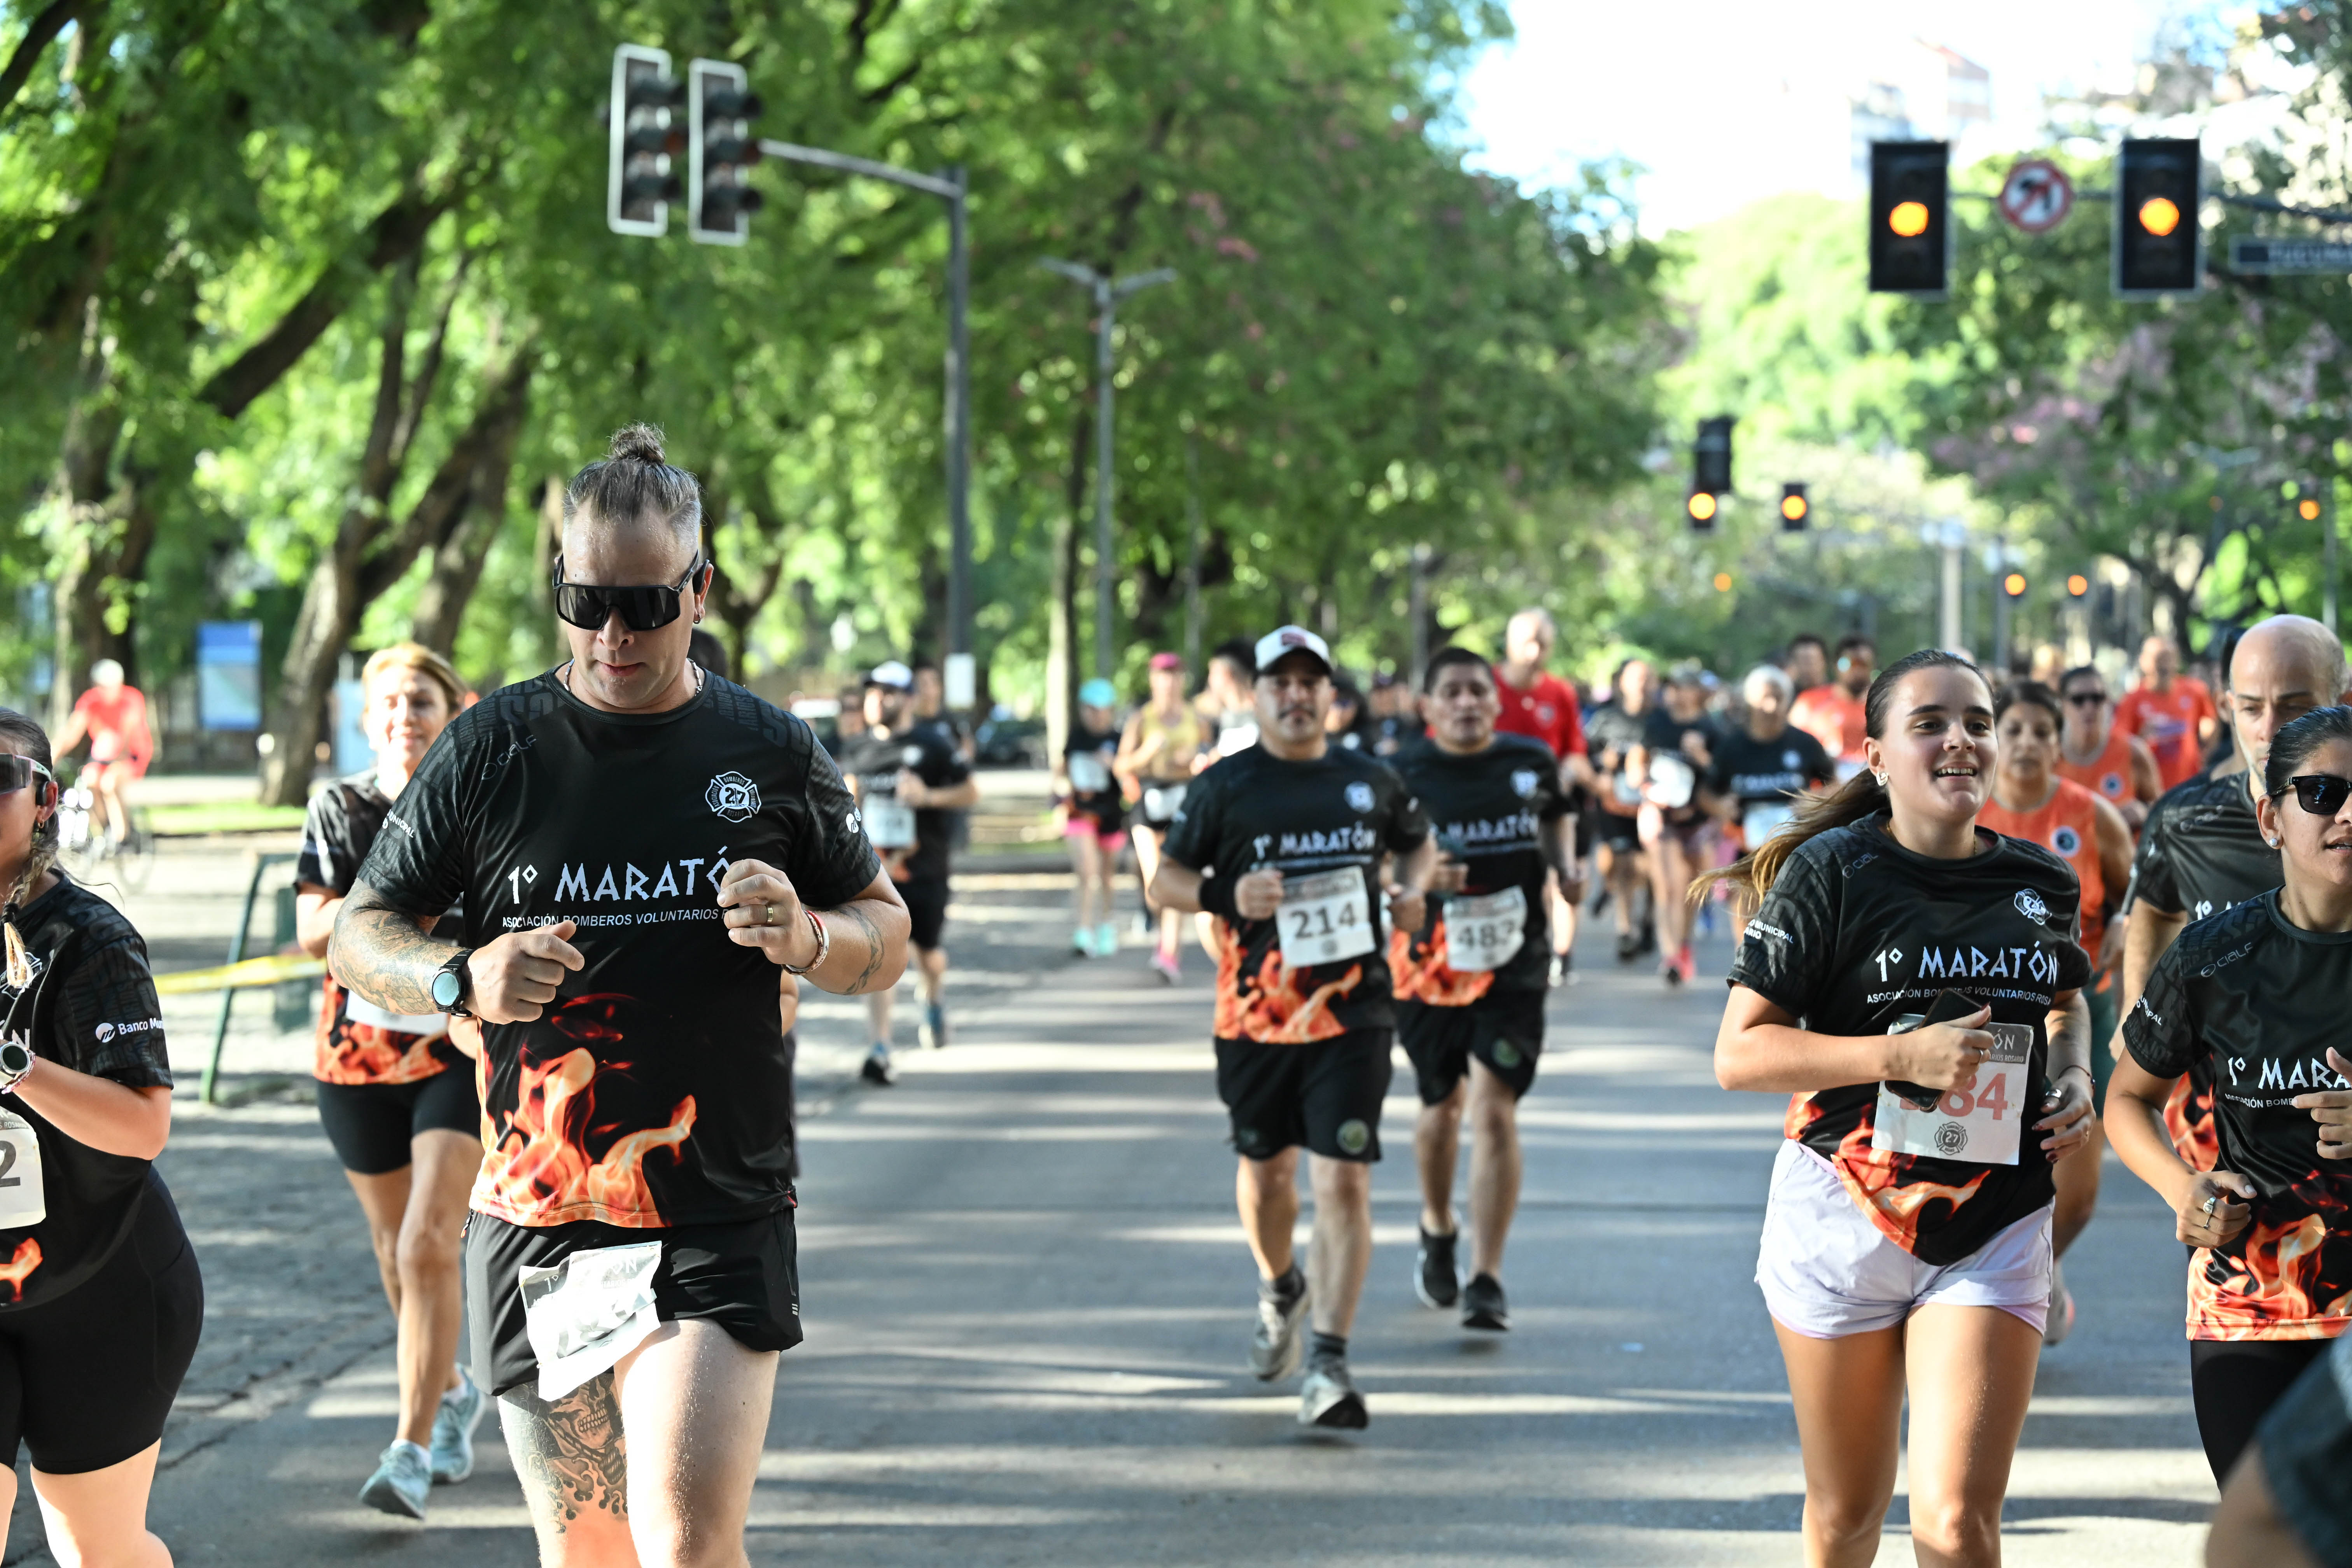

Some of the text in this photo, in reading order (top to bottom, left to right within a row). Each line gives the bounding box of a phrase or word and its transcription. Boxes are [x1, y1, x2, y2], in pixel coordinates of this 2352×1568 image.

[723, 776, 745, 785] BOMBEROS
[554, 845, 730, 902] MARATÓ
[503, 914, 559, 928] ASOCIACIÓN
[637, 909, 718, 924] VOLUNTARIOS
[1289, 901, 1356, 940] 214
[1755, 920, 1794, 944] MUNICIPAL
[1918, 940, 2058, 985] MARATÓN
[1867, 987, 1921, 1004] ASOCIACIÓN
[1975, 987, 2036, 1001] VOLUNTARIOS
[118, 1021, 148, 1035] Banco
[2258, 1057, 2352, 1090] MARA
[1899, 1073, 2008, 1120] 84
[1945, 1131, 1958, 1143] 27
